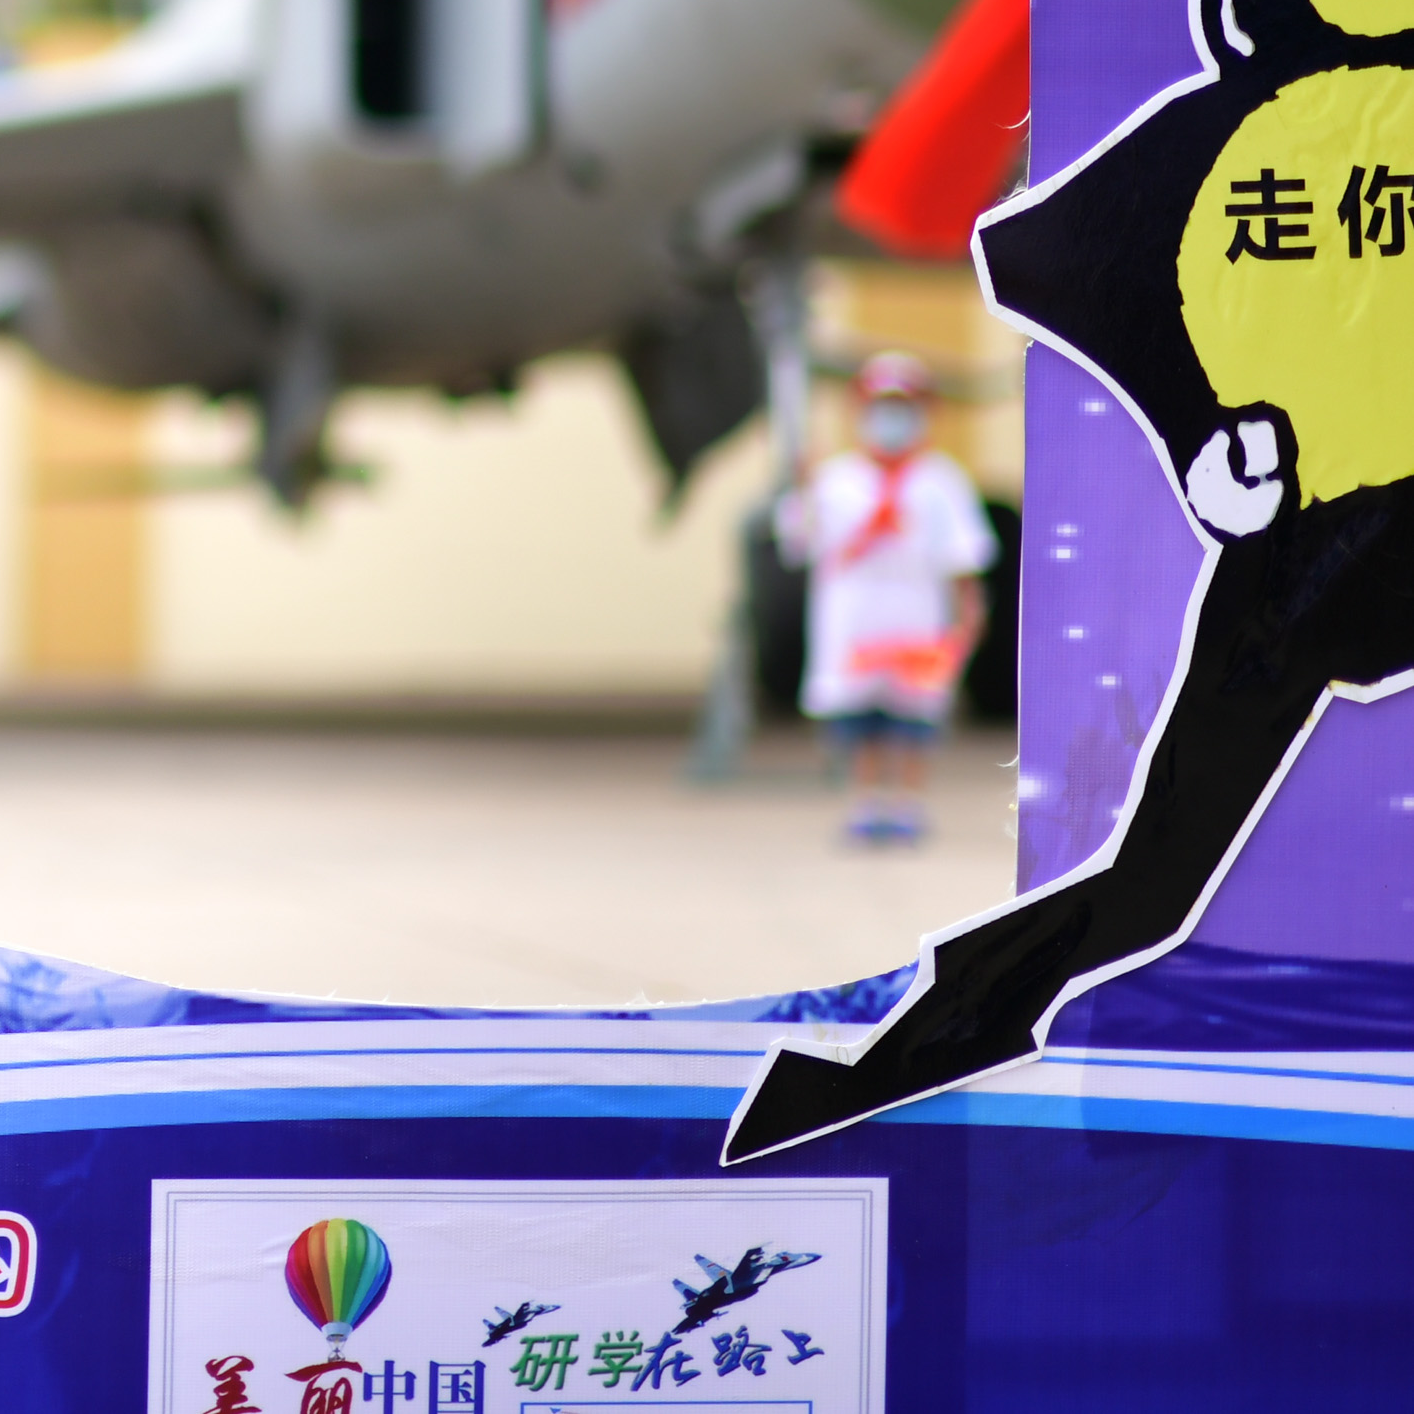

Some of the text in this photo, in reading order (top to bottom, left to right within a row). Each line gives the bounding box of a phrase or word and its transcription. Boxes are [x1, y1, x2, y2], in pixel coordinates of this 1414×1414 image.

[1224, 164, 1414, 264] 走你
[202, 1356, 487, 1414] 美丽中国
[509, 1325, 825, 1392] 研学在路上
